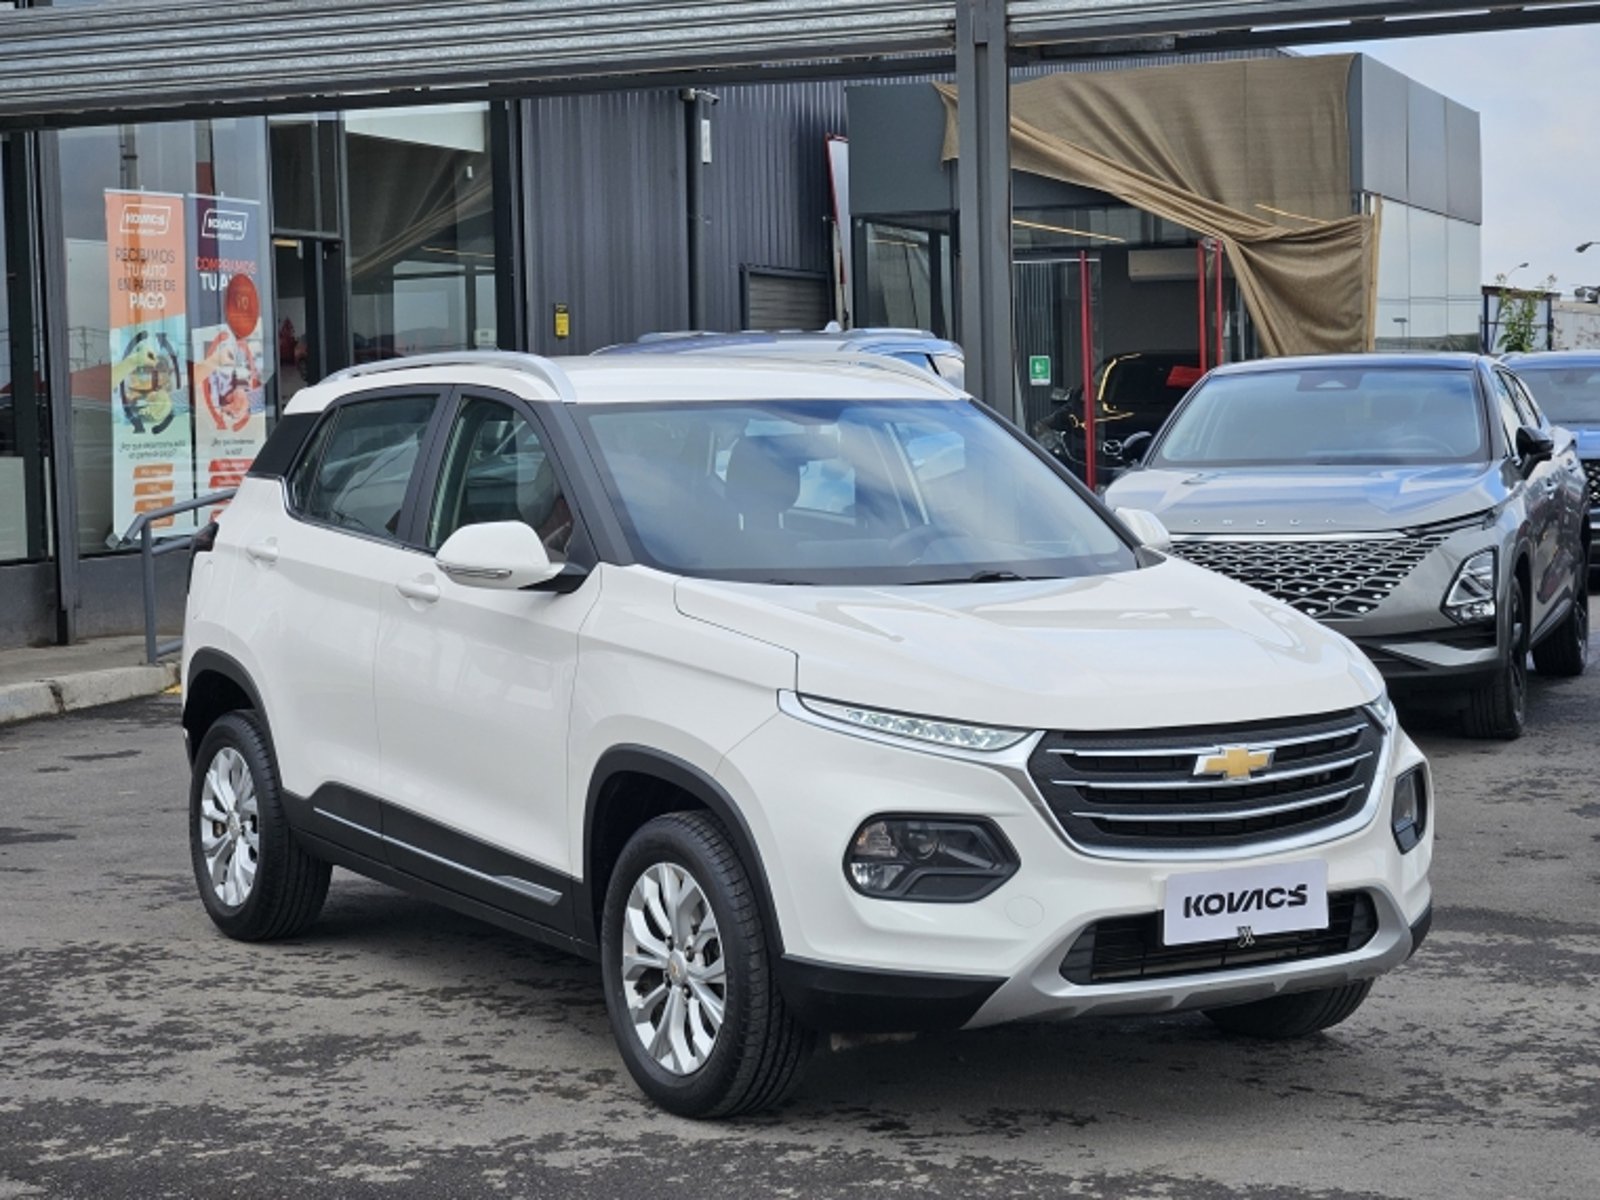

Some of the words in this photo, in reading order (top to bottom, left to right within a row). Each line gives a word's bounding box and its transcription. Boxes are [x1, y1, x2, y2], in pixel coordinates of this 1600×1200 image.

[195, 257, 256, 274] COMPRAMOS
[200, 272, 218, 291] TU
[130, 292, 165, 309] PAGO
[1183, 883, 1308, 919] KOVACS
